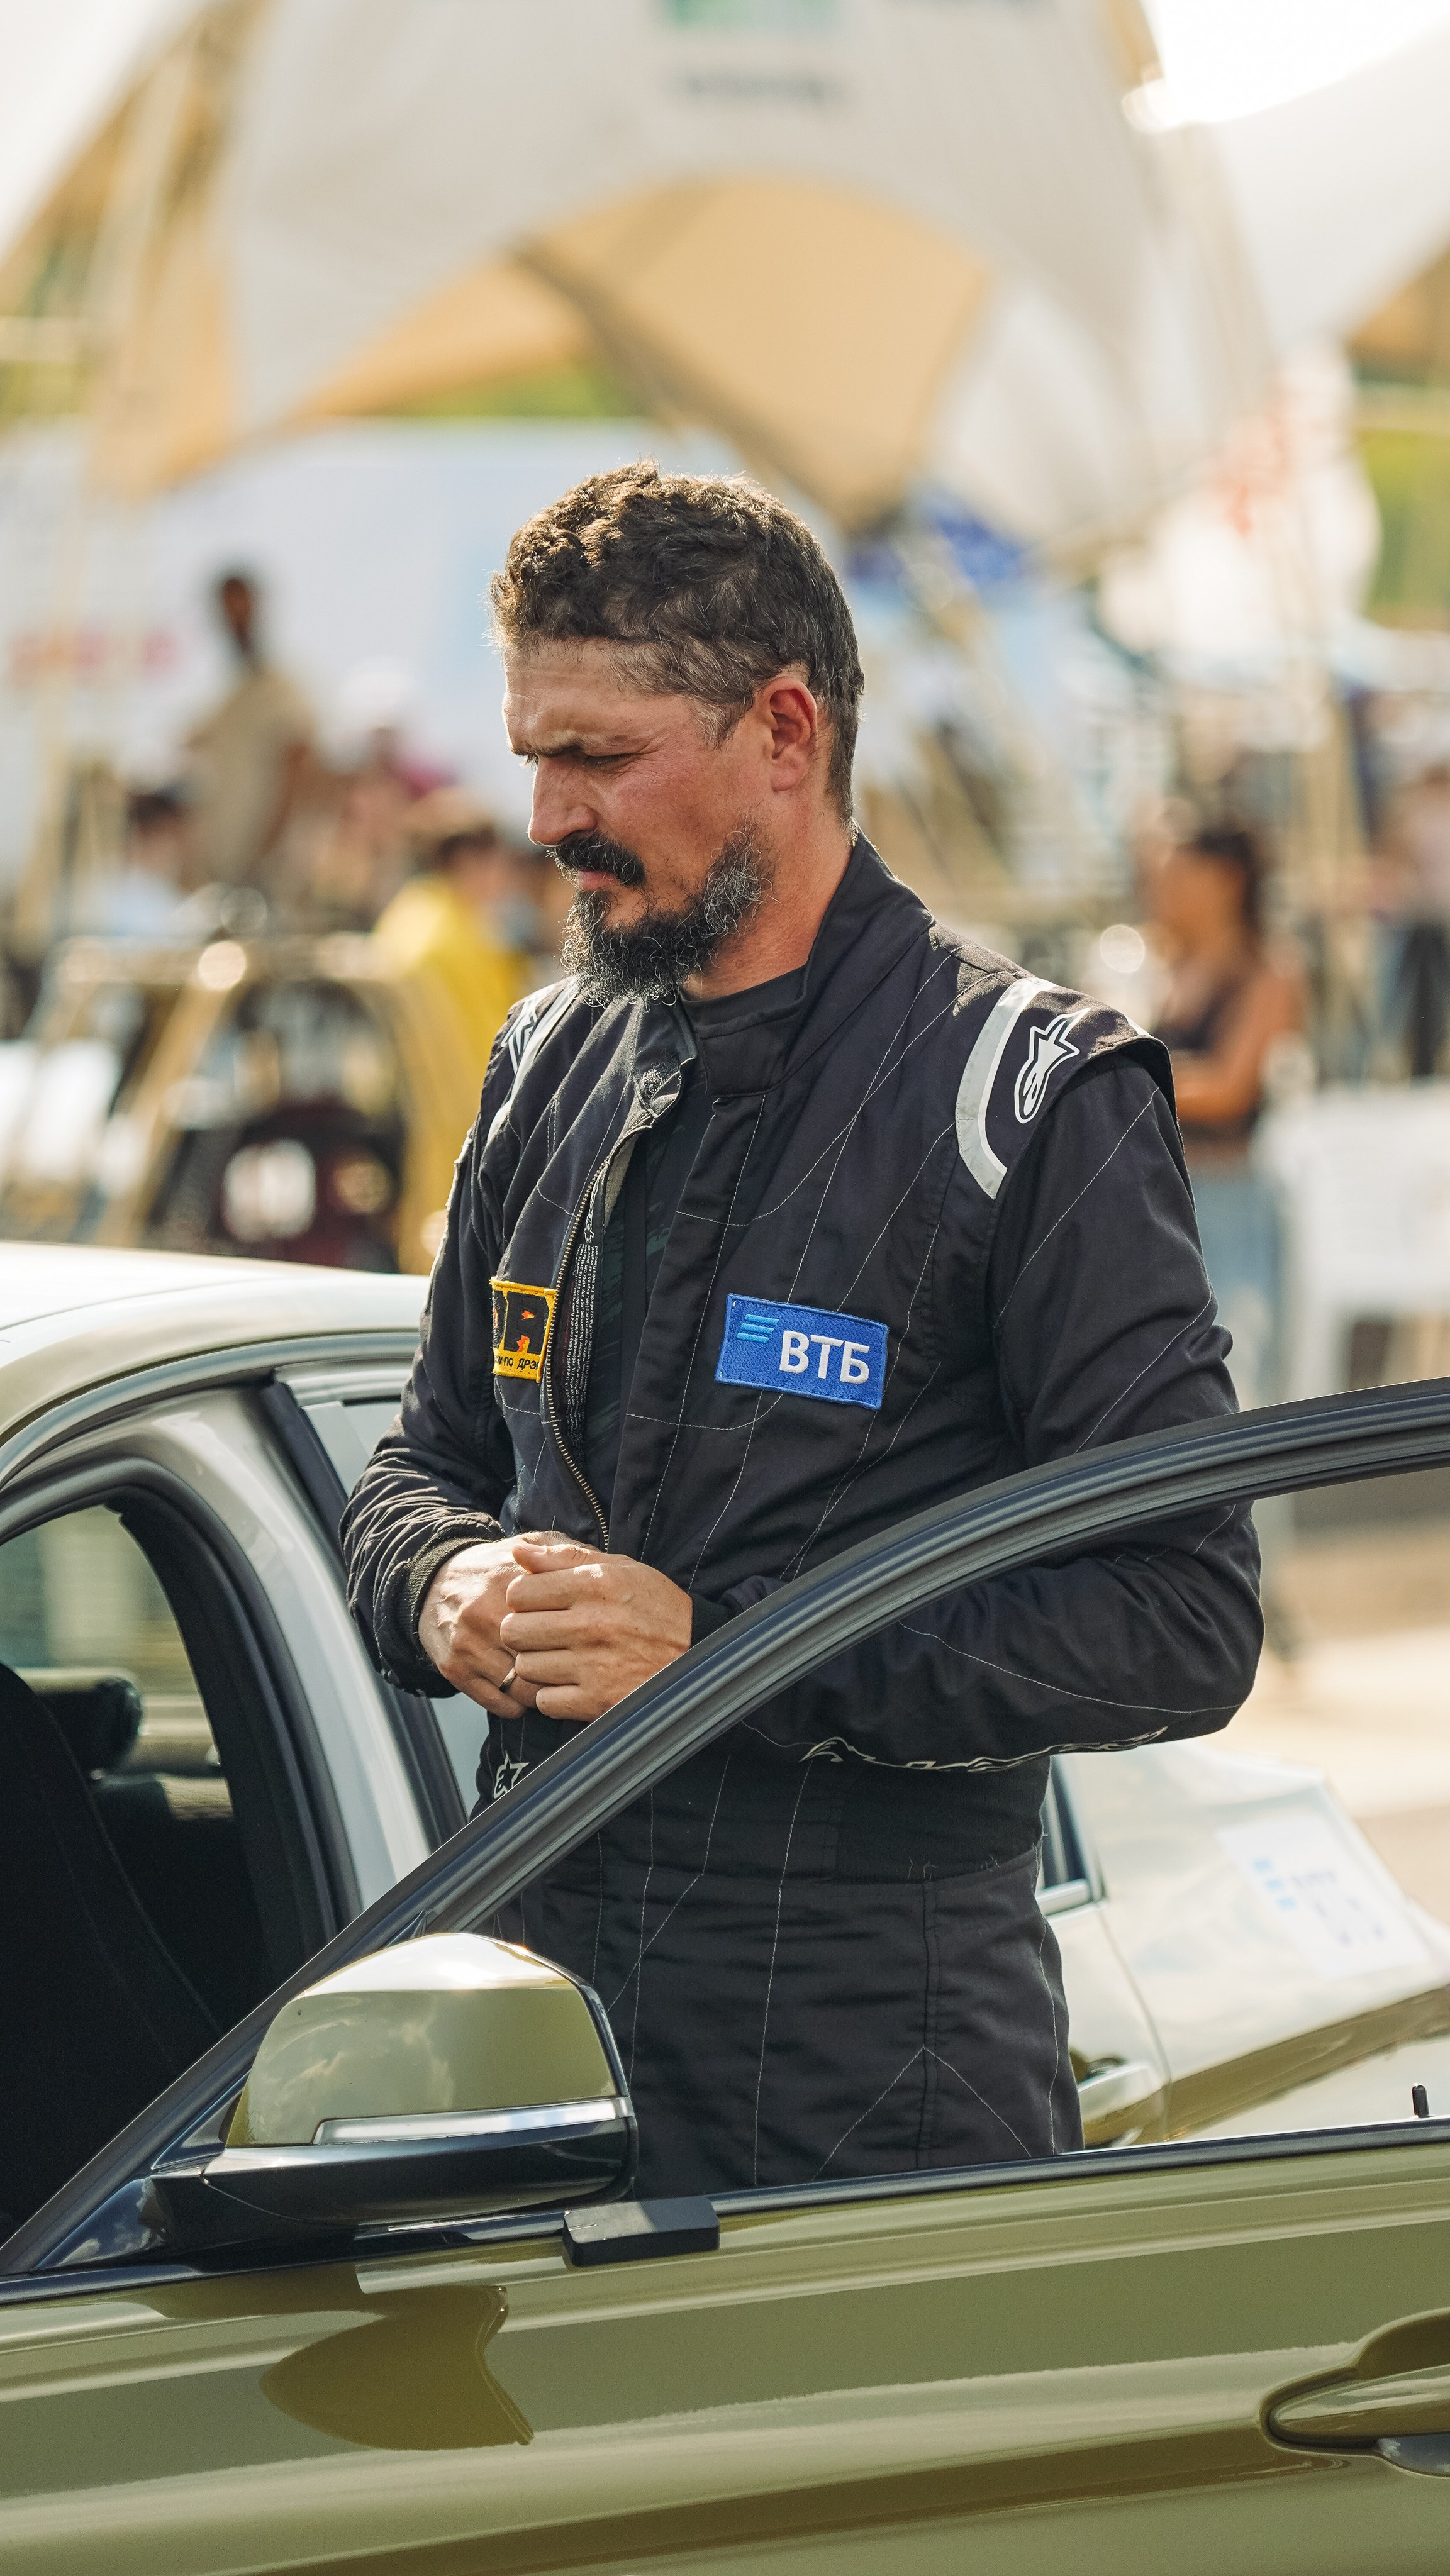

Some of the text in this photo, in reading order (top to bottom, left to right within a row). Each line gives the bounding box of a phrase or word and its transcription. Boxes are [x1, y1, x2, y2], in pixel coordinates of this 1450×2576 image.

[579, 1244, 588, 1270] protective
[504, 1357, 514, 1367] ПО
[779, 1330, 870, 1384] ВТБ
